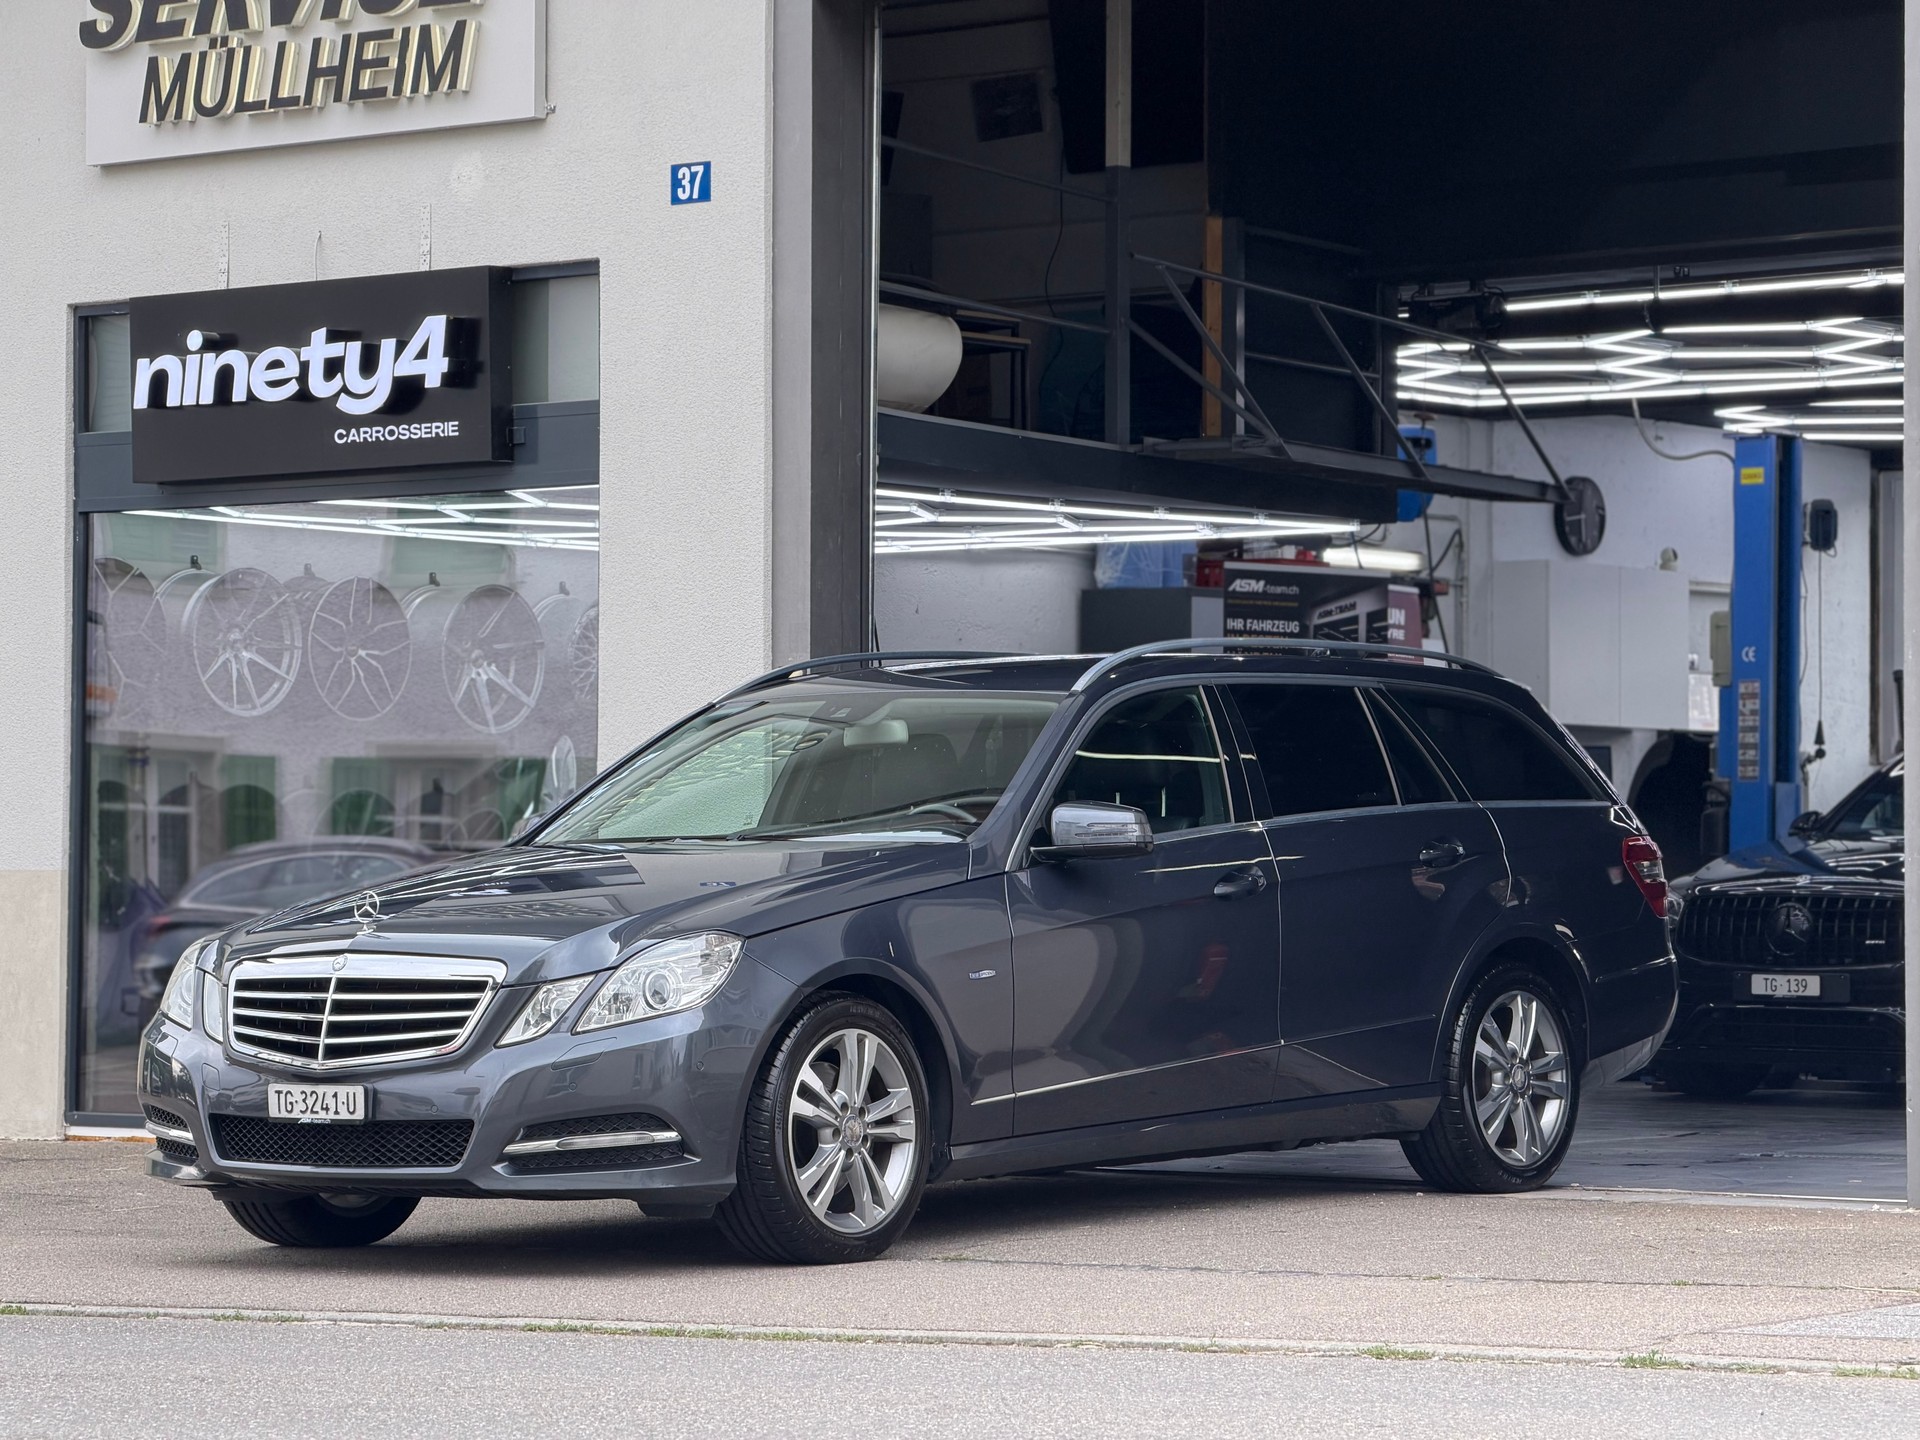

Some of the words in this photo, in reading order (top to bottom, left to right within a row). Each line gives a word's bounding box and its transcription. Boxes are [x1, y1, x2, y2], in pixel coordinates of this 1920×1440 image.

[139, 19, 468, 124] MÜLLHEIM
[677, 165, 704, 200] 37
[133, 314, 449, 415] ninety4
[334, 421, 459, 444] CARROSSERIE
[1226, 617, 1245, 631] IHR
[1246, 619, 1300, 633] FAHRZEUG
